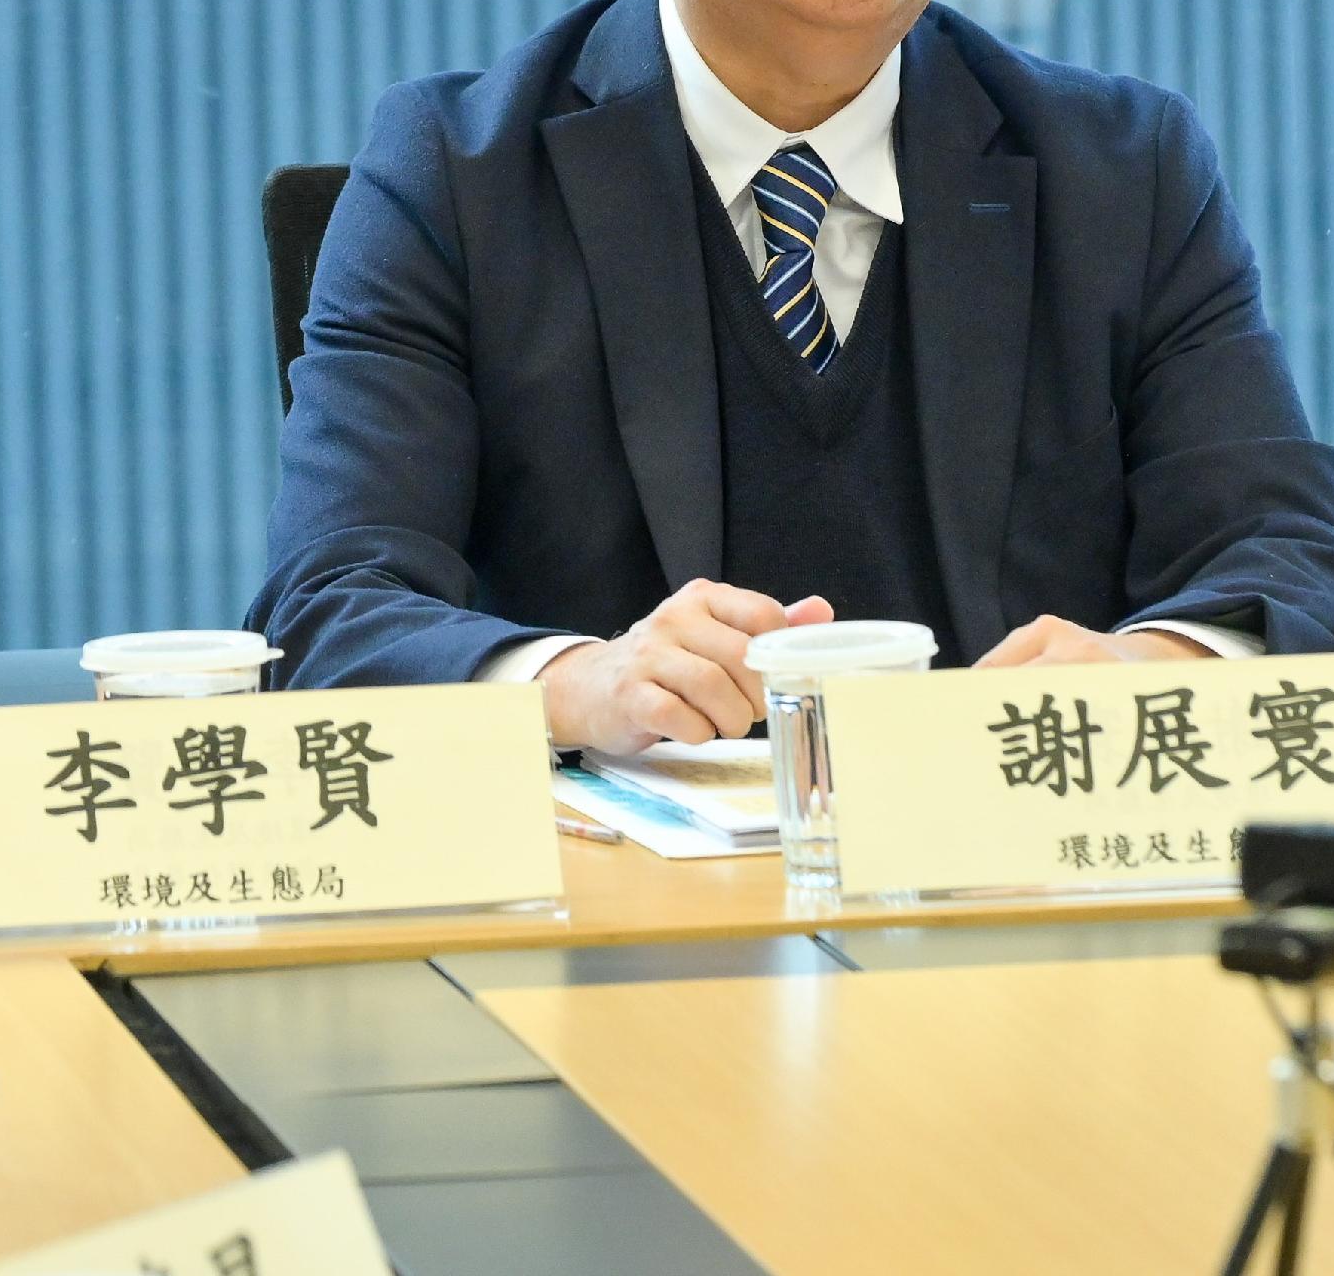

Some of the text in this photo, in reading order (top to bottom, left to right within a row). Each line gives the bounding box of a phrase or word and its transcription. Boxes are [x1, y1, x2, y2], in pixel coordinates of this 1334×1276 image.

[43, 720, 395, 843] 李學賢
[99, 864, 345, 909] 環境及生態局
